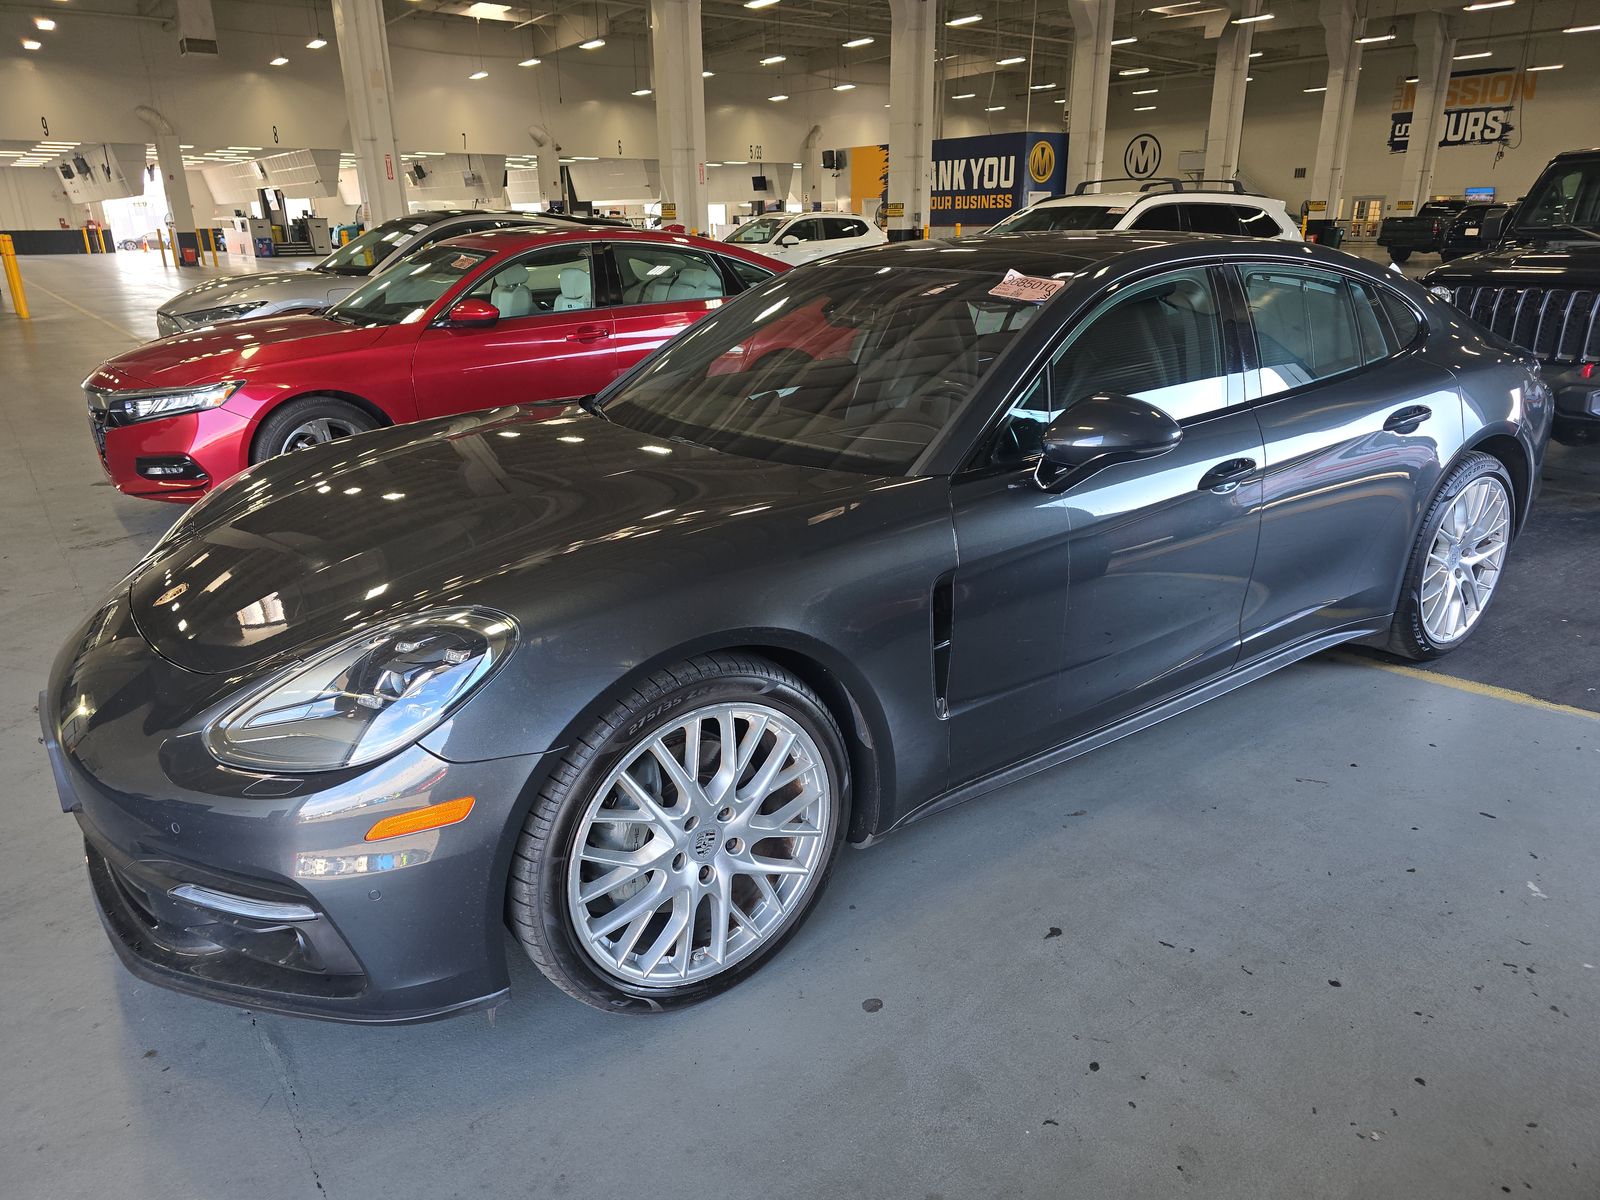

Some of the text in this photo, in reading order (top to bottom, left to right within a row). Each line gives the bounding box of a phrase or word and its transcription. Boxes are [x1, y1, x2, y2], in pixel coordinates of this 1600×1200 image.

[1402, 72, 1538, 112] MSSION
[41, 116, 49, 136] 9
[272, 125, 279, 143] 8
[461, 132, 467, 150] 7
[930, 155, 1016, 191] ANK YOU
[930, 194, 1013, 210] OUR BUSINESS
[628, 698, 682, 736] 275/35
